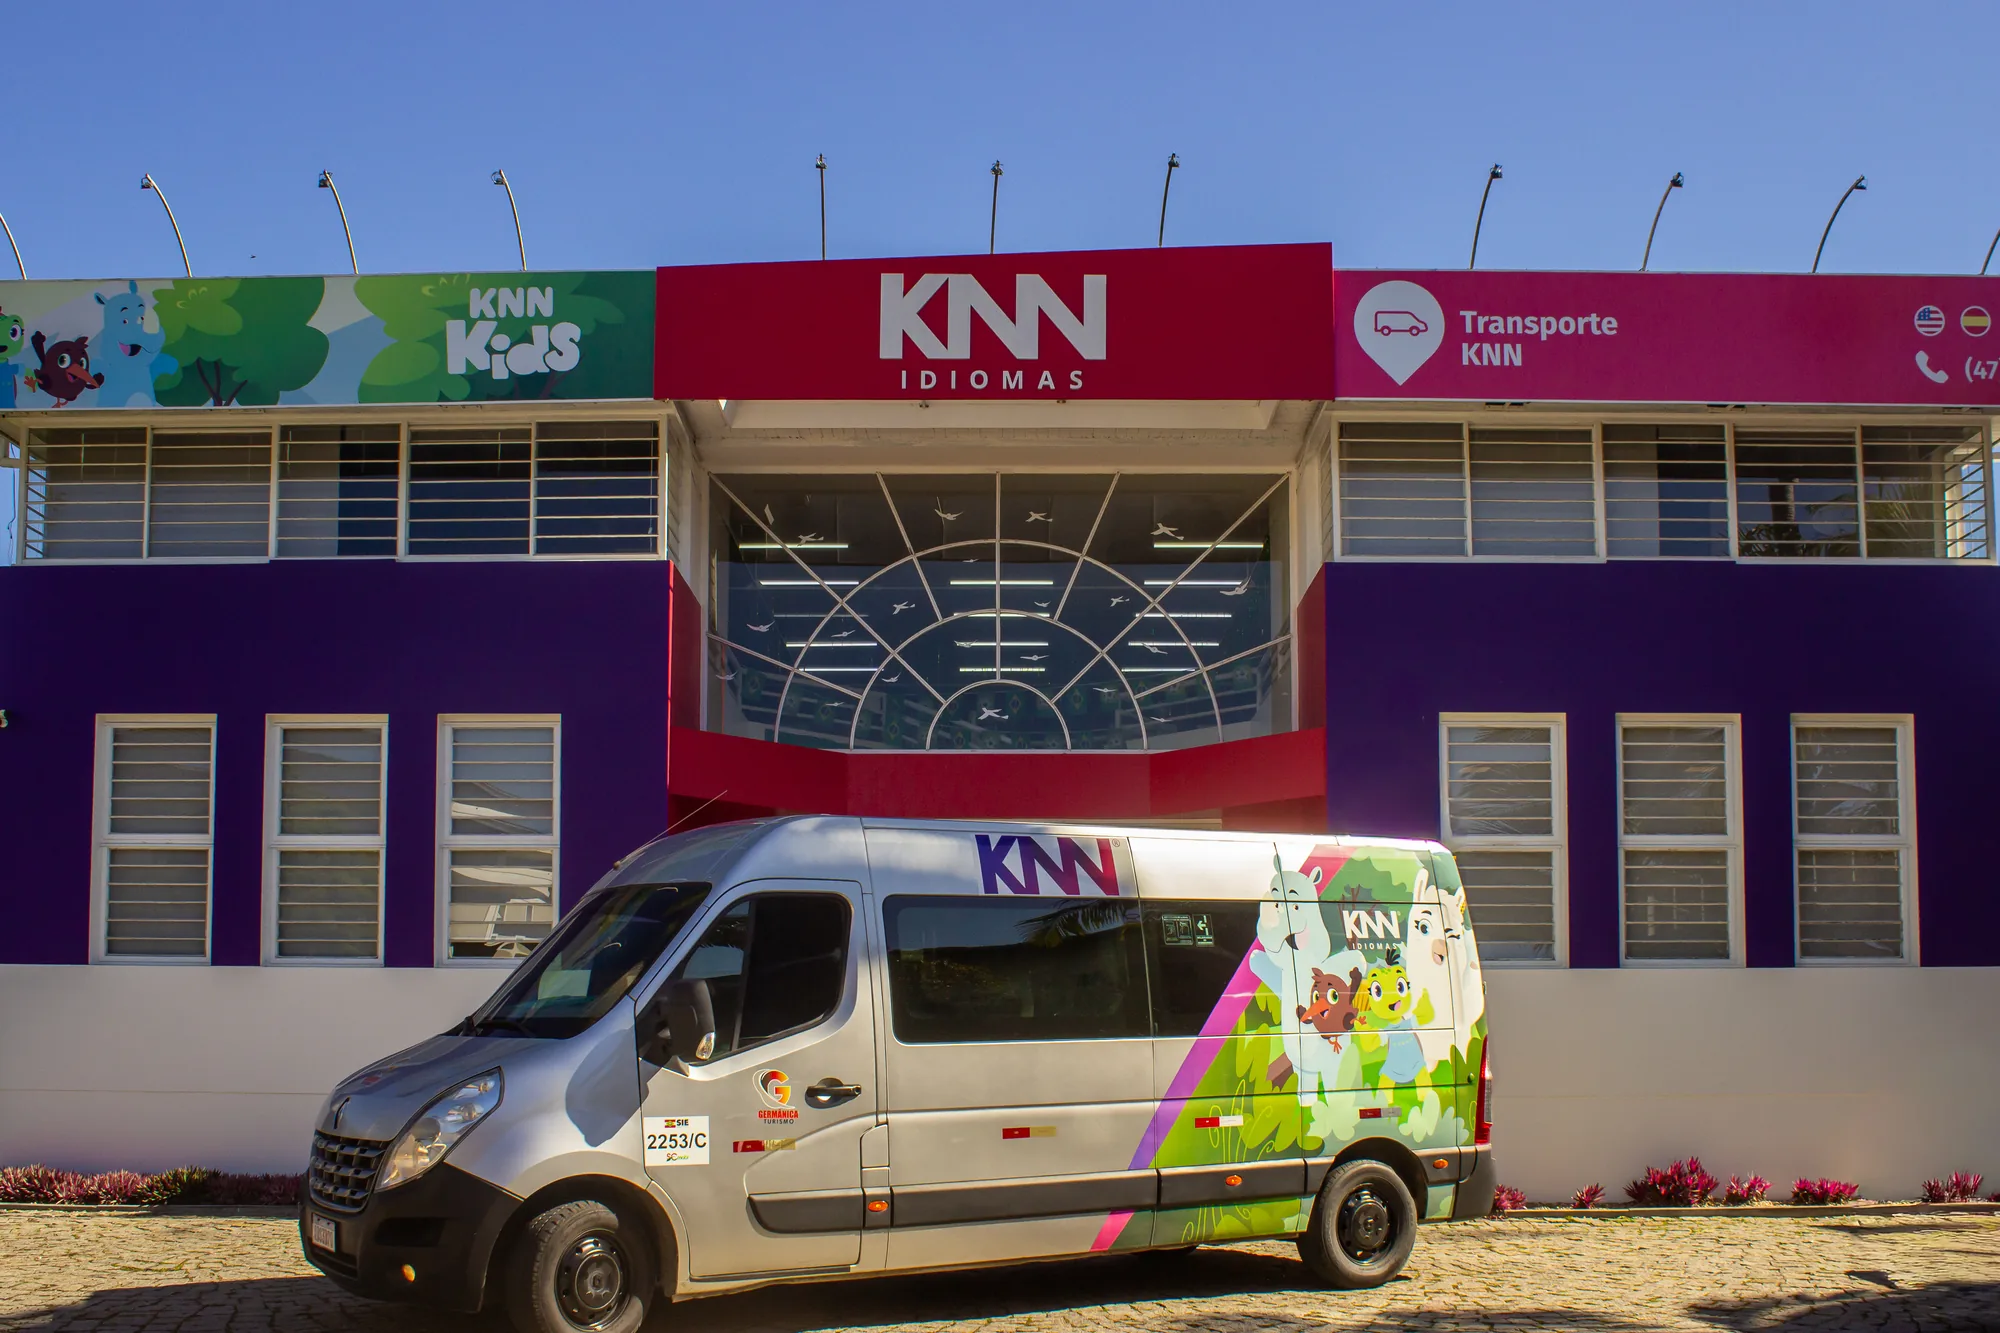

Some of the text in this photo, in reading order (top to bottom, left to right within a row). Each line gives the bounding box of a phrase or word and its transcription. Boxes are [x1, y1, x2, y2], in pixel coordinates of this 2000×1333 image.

[469, 287, 554, 318] KNN
[880, 273, 1107, 360] KNN
[1459, 310, 1618, 341] Transporte
[446, 319, 582, 379] Kids
[1462, 342, 1522, 366] KNN
[901, 370, 1083, 390] IDIOMAS
[1964, 356, 2000, 383] (47
[1352, 942, 1397, 950] IDIOMAS
[758, 1109, 799, 1119] GERMÂNICA
[647, 1132, 707, 1149] 2253/C
